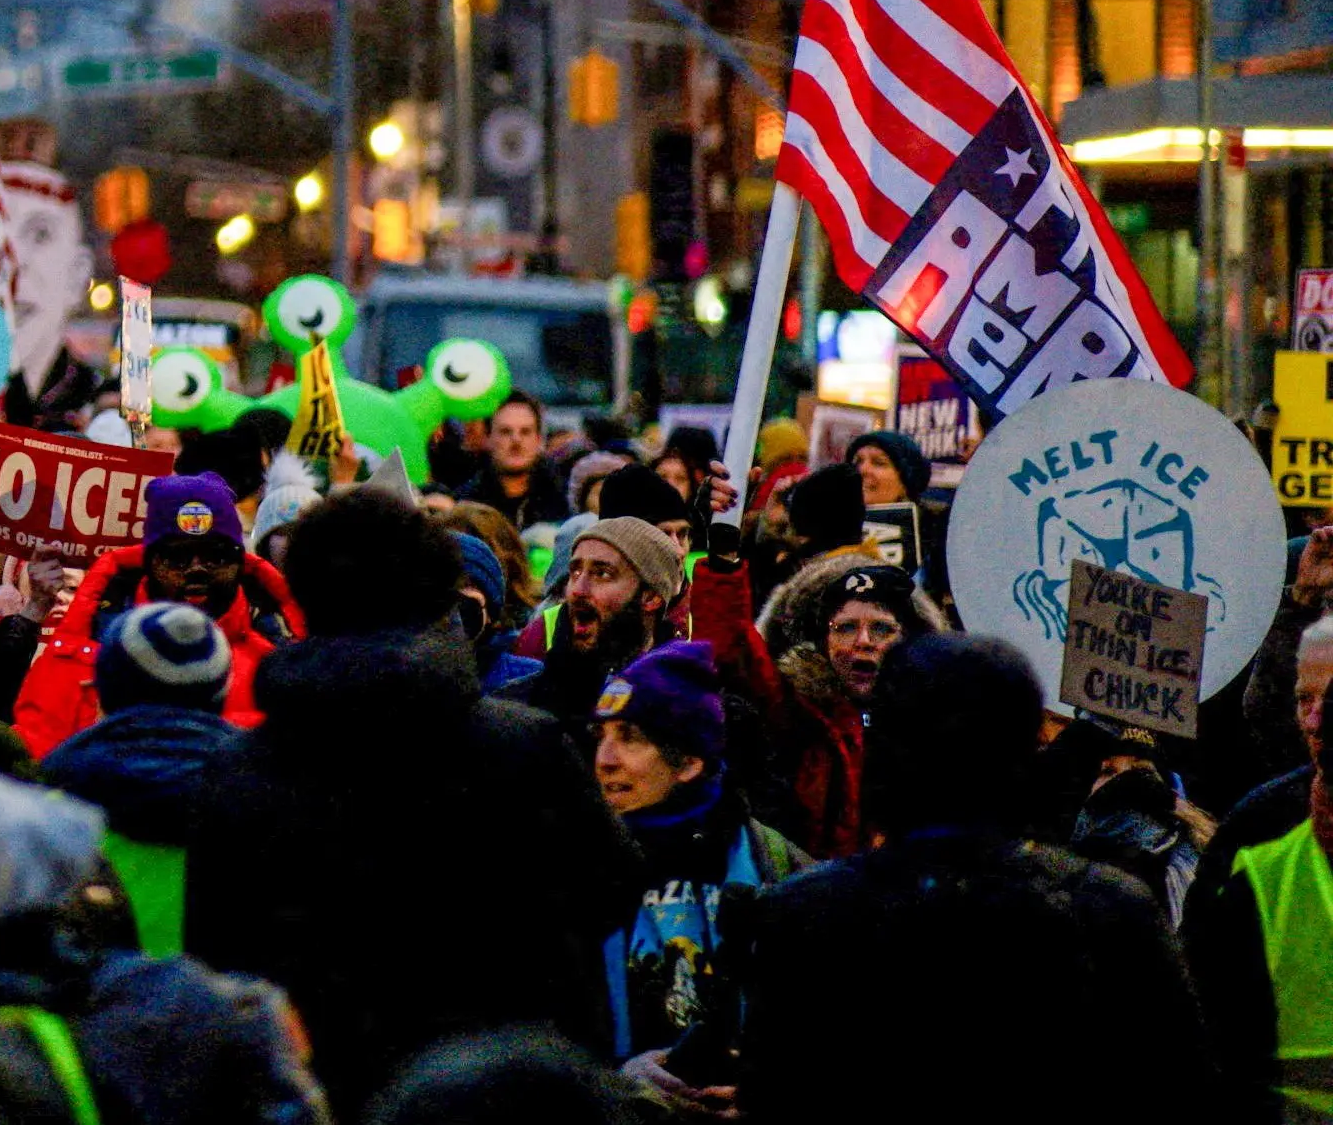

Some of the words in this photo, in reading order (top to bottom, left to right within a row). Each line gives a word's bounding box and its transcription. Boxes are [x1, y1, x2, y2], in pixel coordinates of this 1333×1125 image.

[899, 397, 959, 436] NEW
[1008, 429, 1118, 496] MELT
[1140, 441, 1210, 500] ICE
[16, 531, 44, 550] OFF
[1072, 619, 1137, 667] THIN
[1115, 609, 1153, 642] ON
[1085, 667, 1184, 723] CHUCK
